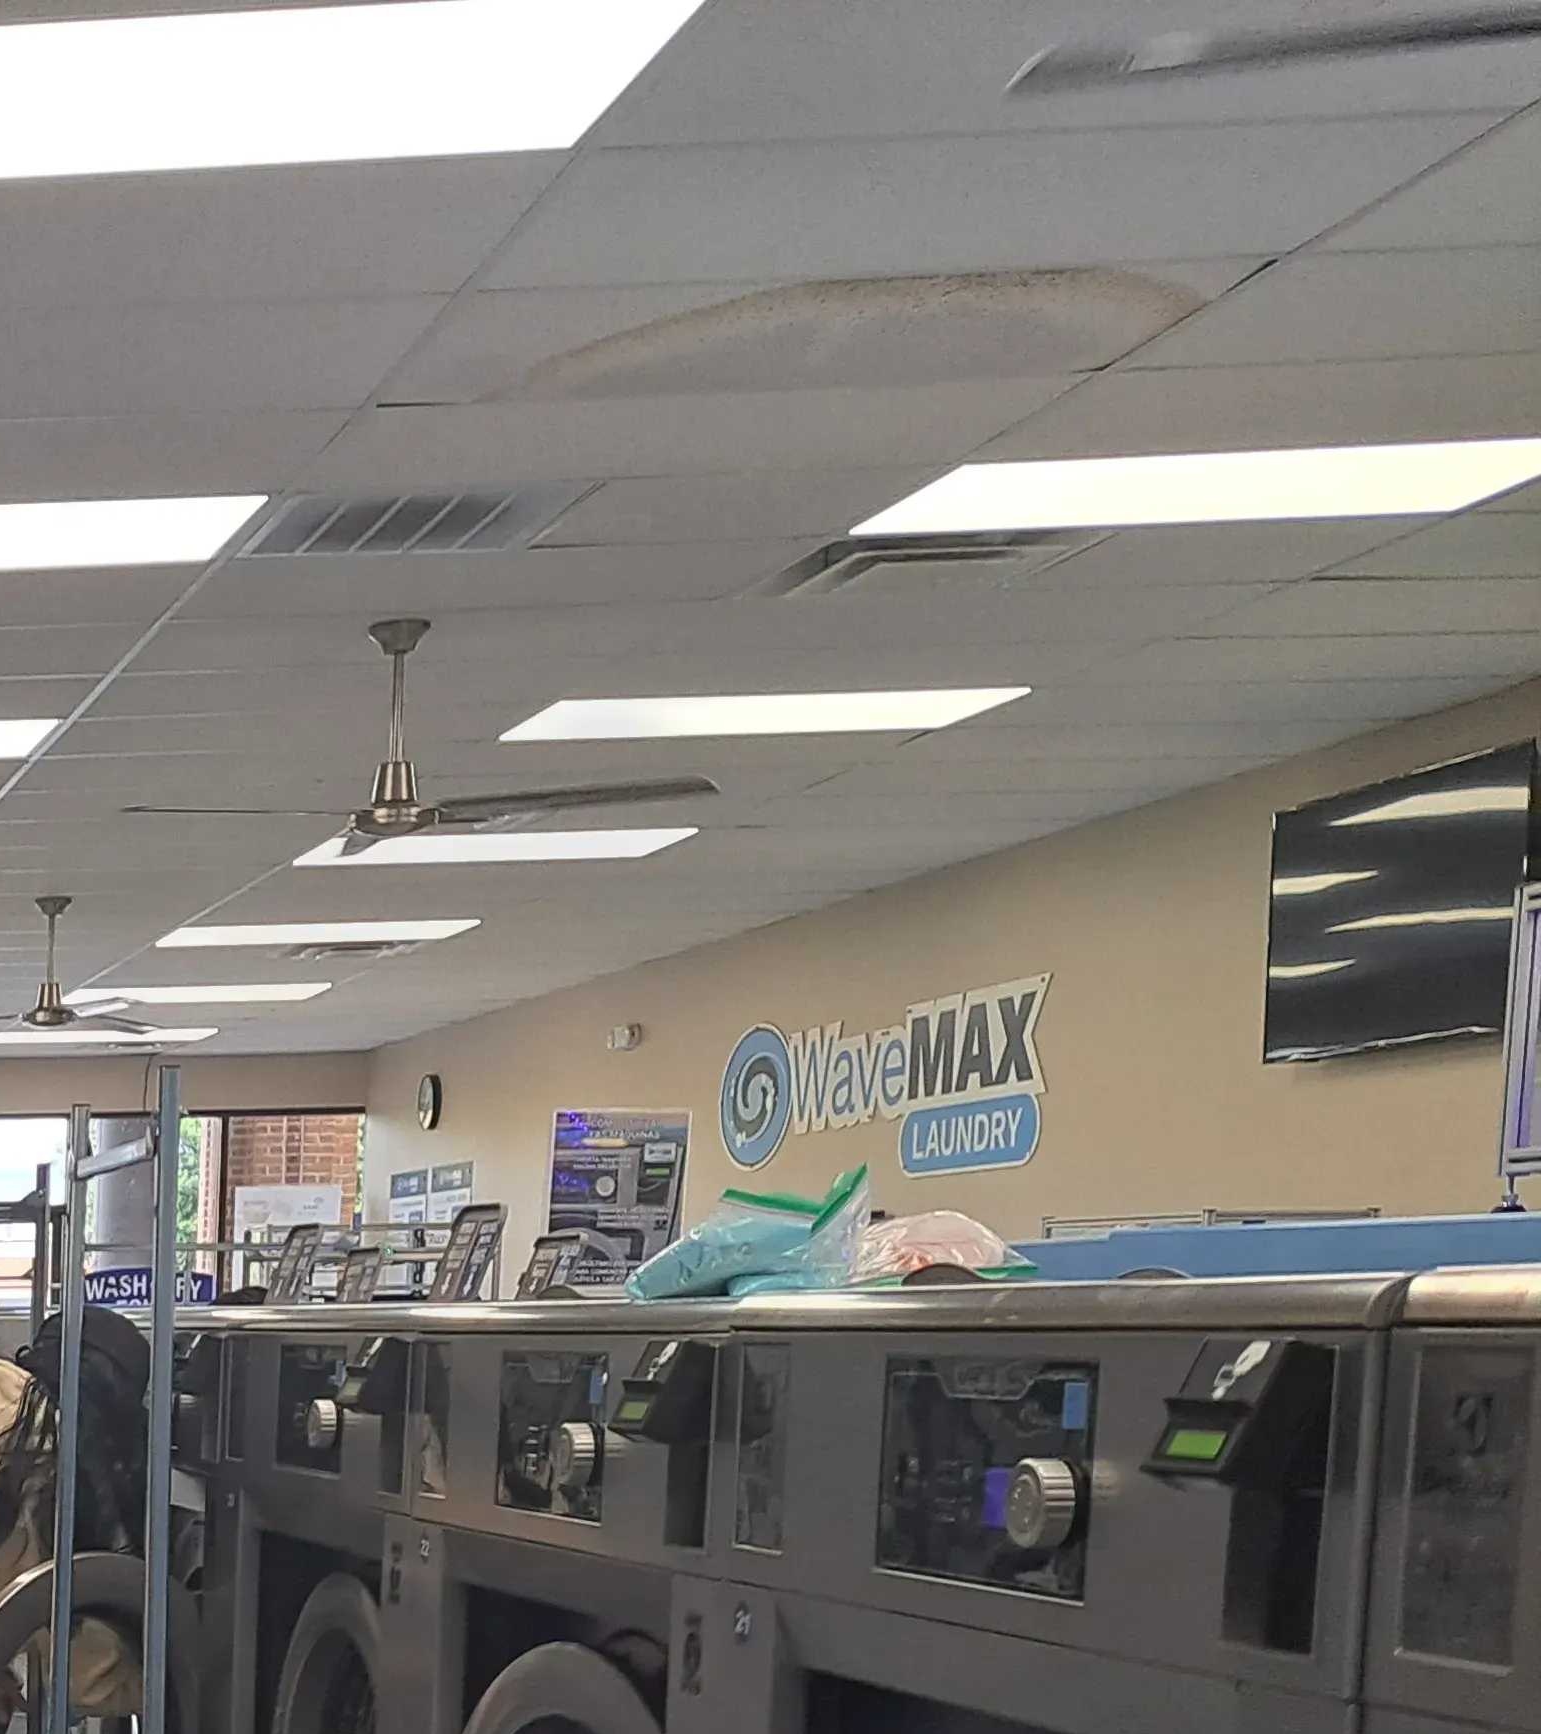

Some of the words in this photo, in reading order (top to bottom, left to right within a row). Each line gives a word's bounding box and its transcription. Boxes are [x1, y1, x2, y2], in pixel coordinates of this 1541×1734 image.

[793, 990, 1038, 1122] WaveMAX
[911, 1107, 1024, 1160] LAUNDRY
[85, 1273, 147, 1301] WASH
